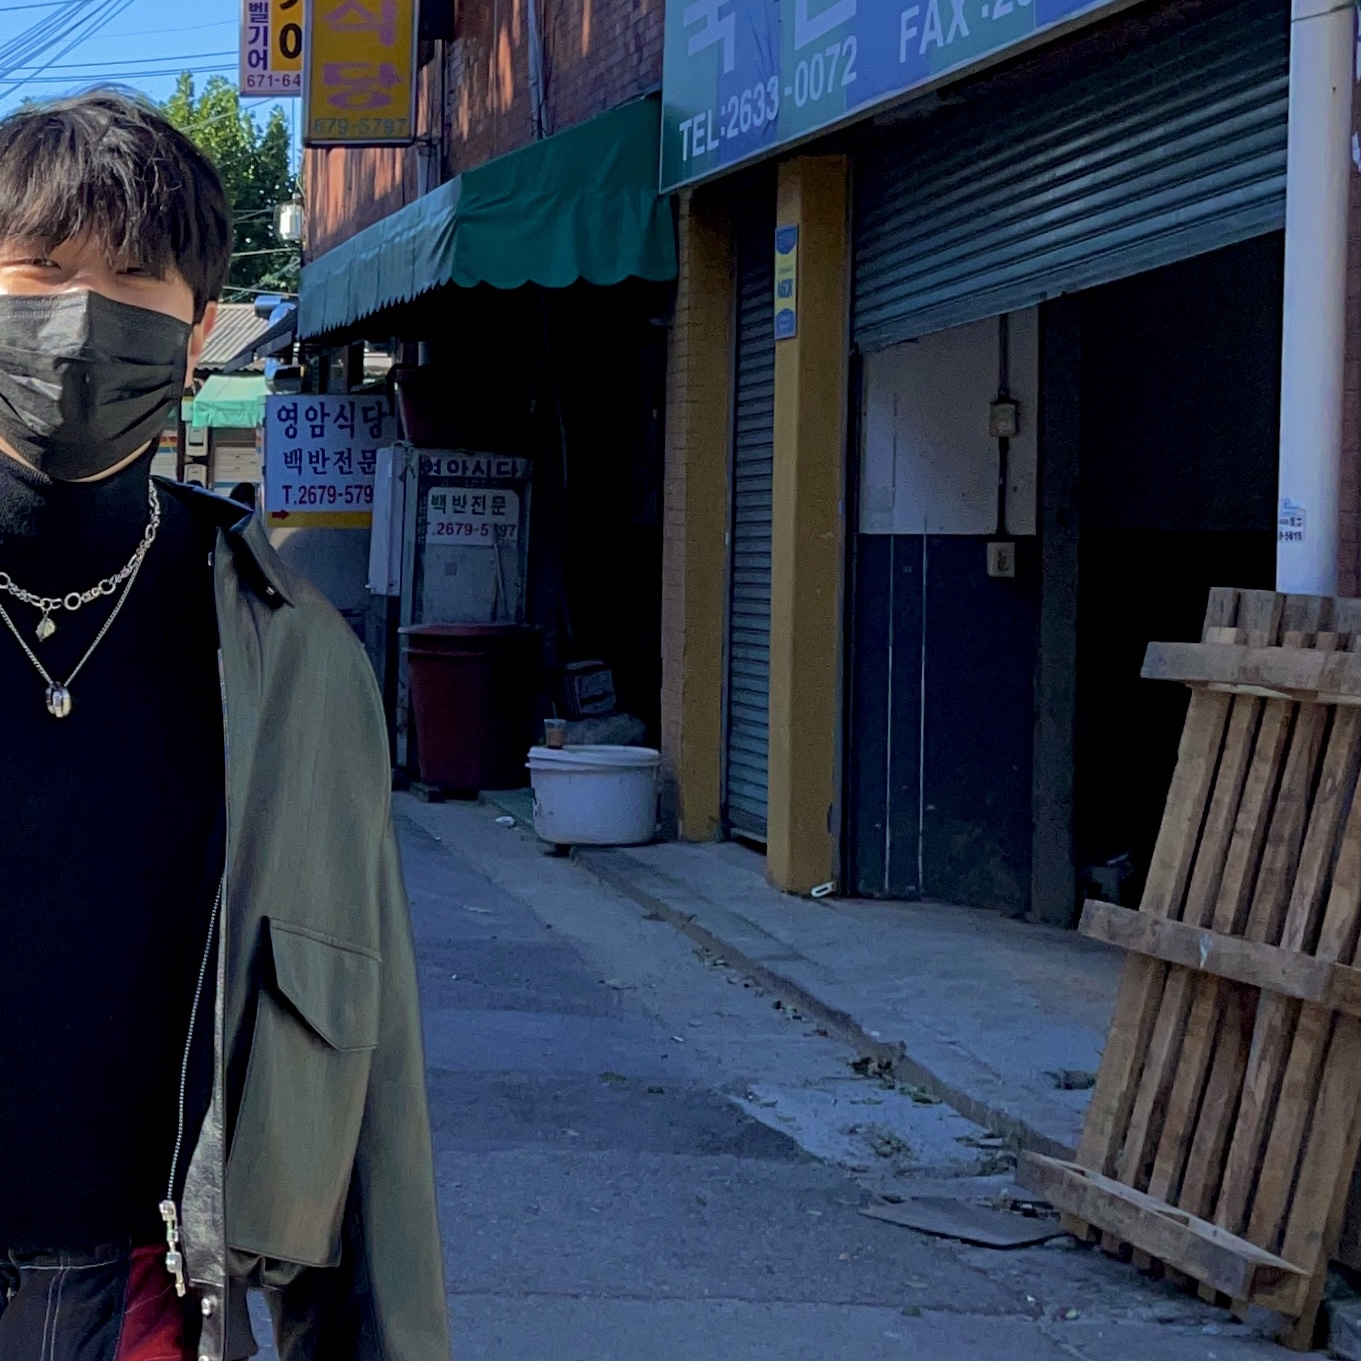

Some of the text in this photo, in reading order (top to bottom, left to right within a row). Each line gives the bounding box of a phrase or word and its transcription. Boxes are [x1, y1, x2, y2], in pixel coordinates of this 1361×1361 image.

[276, 401, 388, 439] 영암식당
[283, 448, 377, 476] 백반전문
[425, 522, 516, 537] .2679-597
